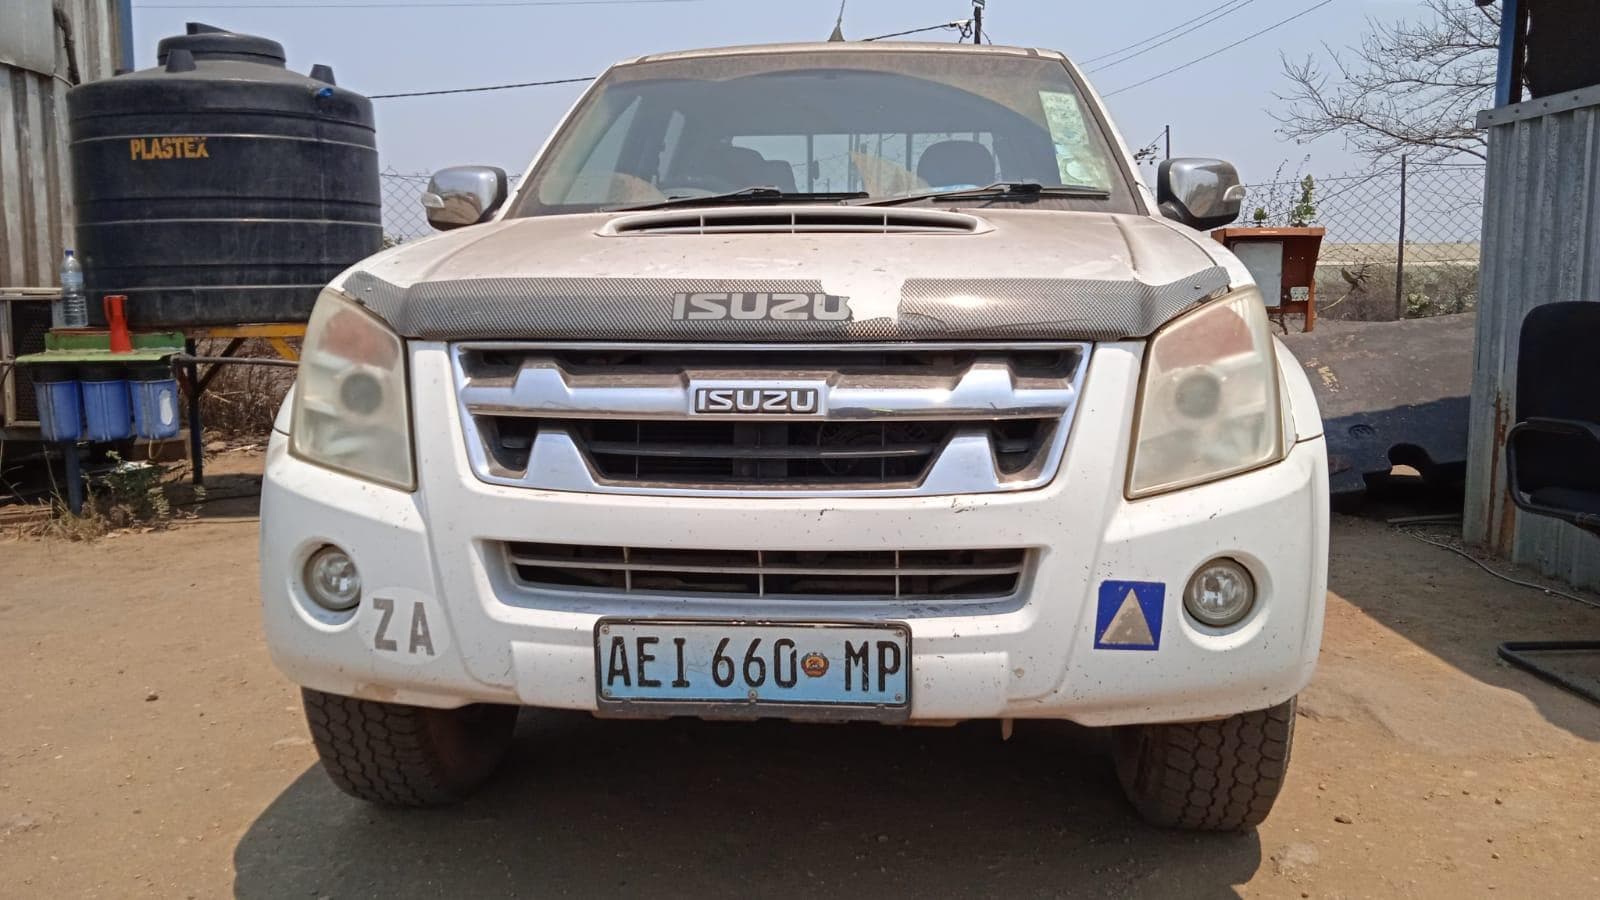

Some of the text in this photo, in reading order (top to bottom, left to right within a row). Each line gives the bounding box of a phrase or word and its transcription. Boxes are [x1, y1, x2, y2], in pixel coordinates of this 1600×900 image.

[130, 137, 209, 160] PLASTEX
[672, 292, 852, 321] ISUZU
[697, 389, 816, 412] ISUZU
[607, 636, 902, 692] AEI 660 MP
